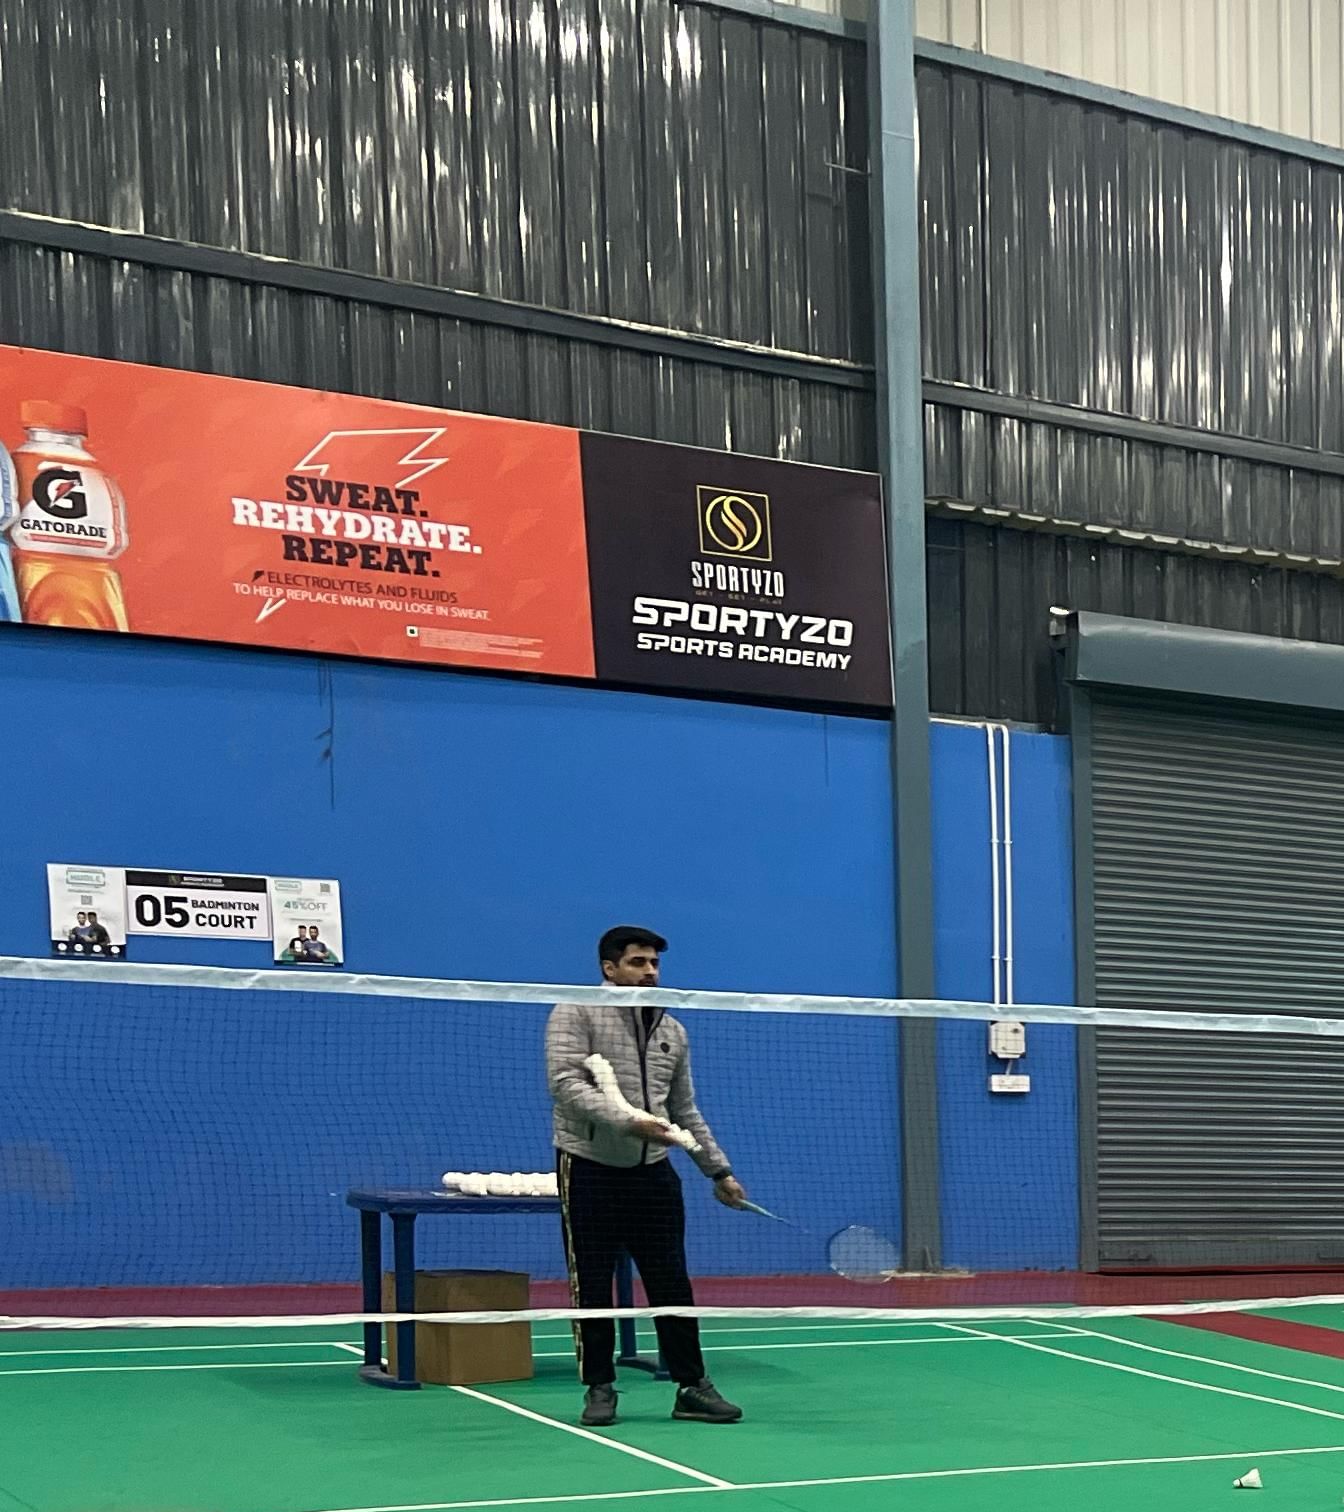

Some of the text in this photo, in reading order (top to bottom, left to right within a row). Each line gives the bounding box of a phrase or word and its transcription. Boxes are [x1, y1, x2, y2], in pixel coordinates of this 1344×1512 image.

[285, 474, 429, 518] SWEAT.
[20, 518, 108, 538] GATORADE
[231, 496, 483, 554] REHYDRATE.
[281, 533, 441, 578] REPEAT.
[266, 570, 458, 604] ELECTROLYTES AND FLUIDS
[690, 560, 785, 598] SPORTYZO
[233, 582, 493, 622] TO HELP REPLACE WHAT YOU LOSE IN SWEAT.
[632, 595, 855, 648] SPORTYZO
[636, 632, 853, 671] SPORTS ACADEMY
[135, 893, 190, 928] 05
[191, 899, 260, 912] BADMINTON
[195, 913, 257, 929] COURT
